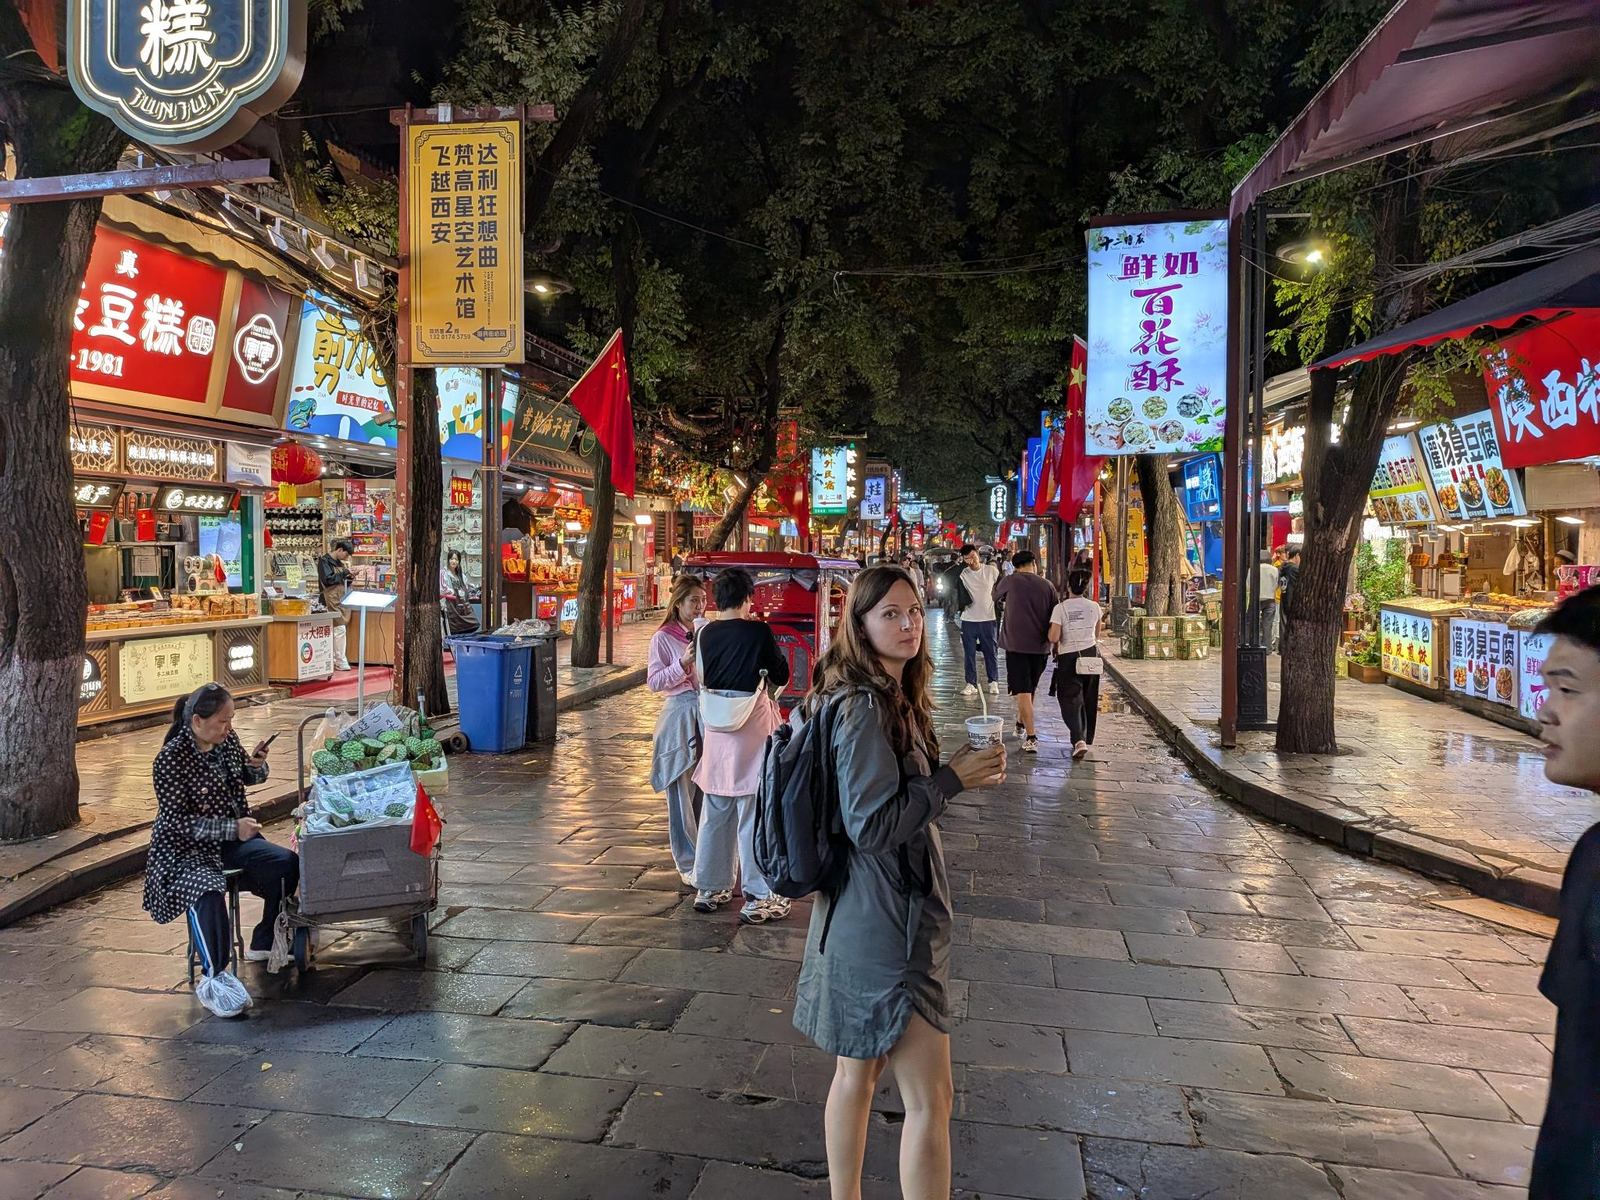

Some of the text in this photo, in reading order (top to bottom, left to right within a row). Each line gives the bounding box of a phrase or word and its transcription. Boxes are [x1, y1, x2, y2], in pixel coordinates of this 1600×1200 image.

[139, 0, 216, 76] 糕
[430, 145, 452, 244] 飞越西安
[454, 143, 476, 319] 梵高星空艺术馆
[477, 142, 499, 268] 达利狂想曲
[1118, 251, 1200, 281] 鲜奶
[1131, 283, 1185, 393] 百花酥
[1423, 420, 1500, 470] 灌汤臭豆腐
[1452, 626, 1515, 667] 灌汤臭豆腐
